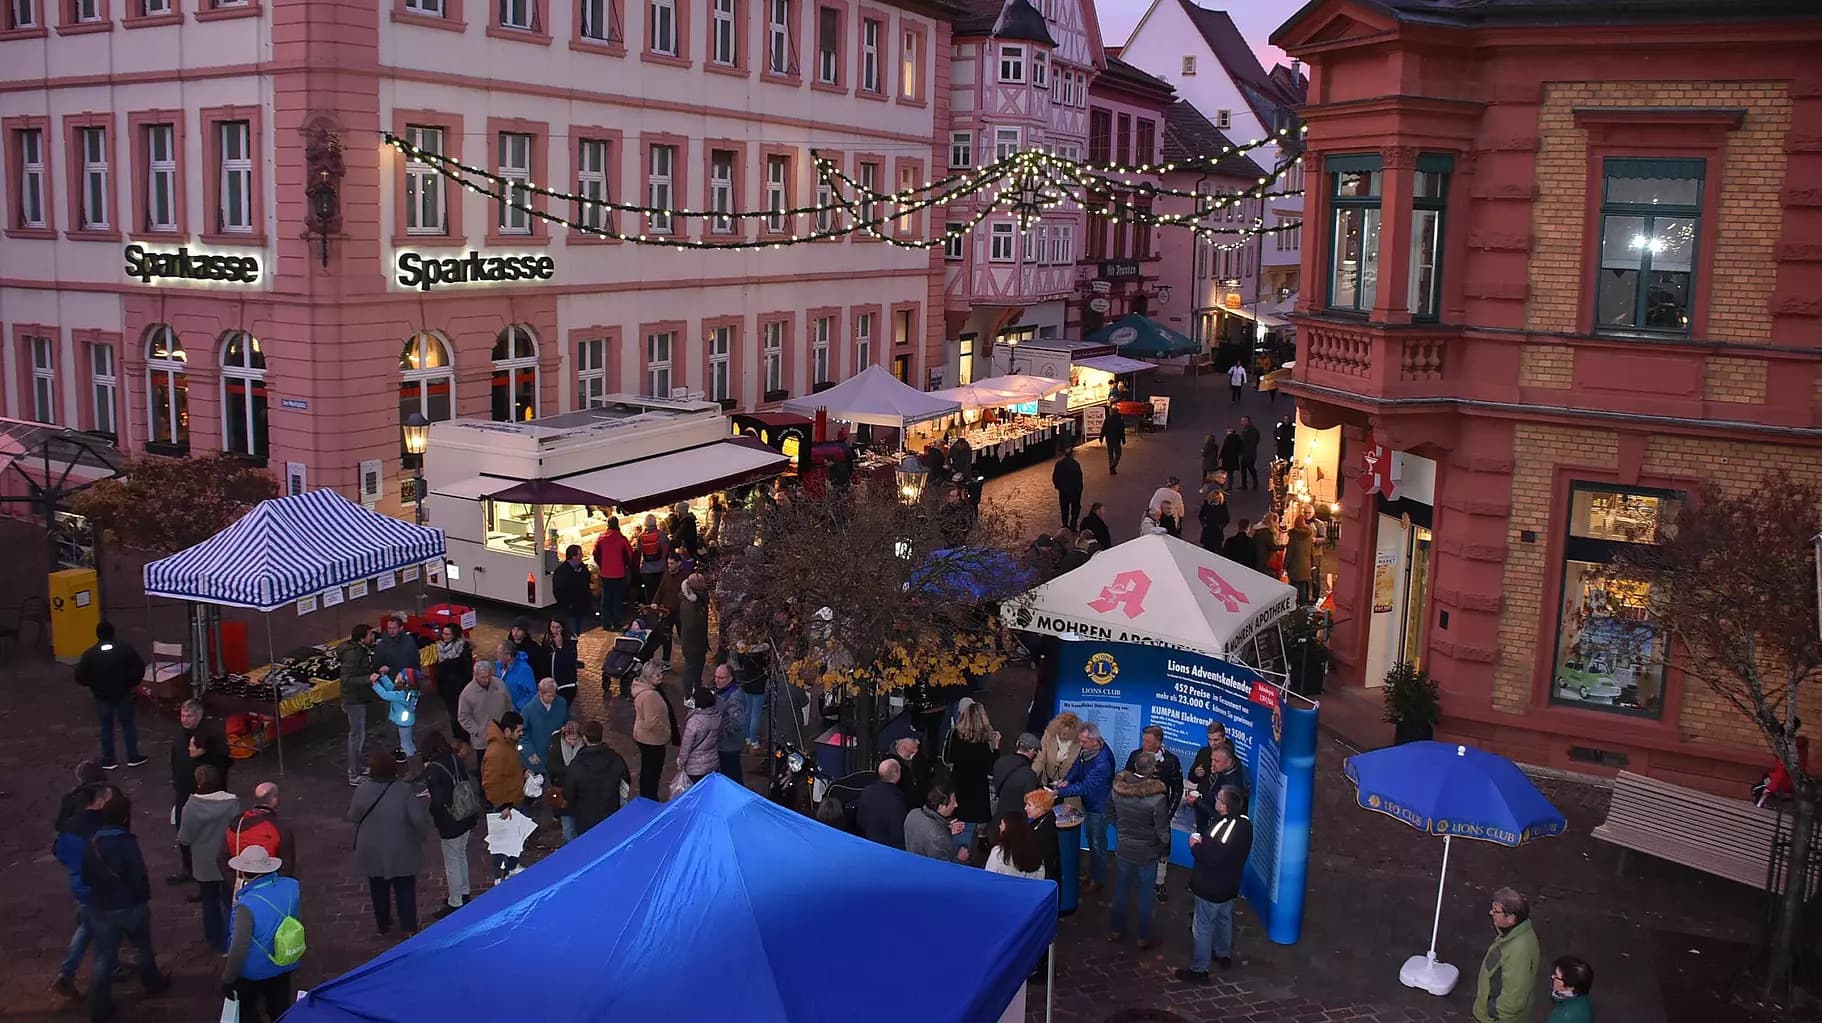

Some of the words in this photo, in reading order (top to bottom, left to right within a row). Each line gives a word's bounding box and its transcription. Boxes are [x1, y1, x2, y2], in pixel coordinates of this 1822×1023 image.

[124, 245, 258, 283] Sparkasse
[398, 251, 554, 290] Sparkasse
[1037, 616, 1112, 642] MOHREN
[1230, 623, 1254, 652] MOHREN
[1255, 597, 1290, 628] APOTHEKE
[1168, 660, 1190, 675] Lions
[1191, 665, 1252, 694] Adventskalender
[1174, 682, 1188, 693] 452
[1189, 686, 1211, 698] Preise
[1156, 692, 1169, 700] mehr
[1178, 694, 1204, 708] 23.000
[1205, 701, 1210, 710] €
[1152, 706, 1180, 720] KUMPAN
[1181, 712, 1213, 727] Elektroroll
[1384, 800, 1400, 814] LEO
[1402, 808, 1422, 826] CLUB
[1452, 823, 1484, 834] LIONS
[1486, 828, 1515, 842] CLUB
